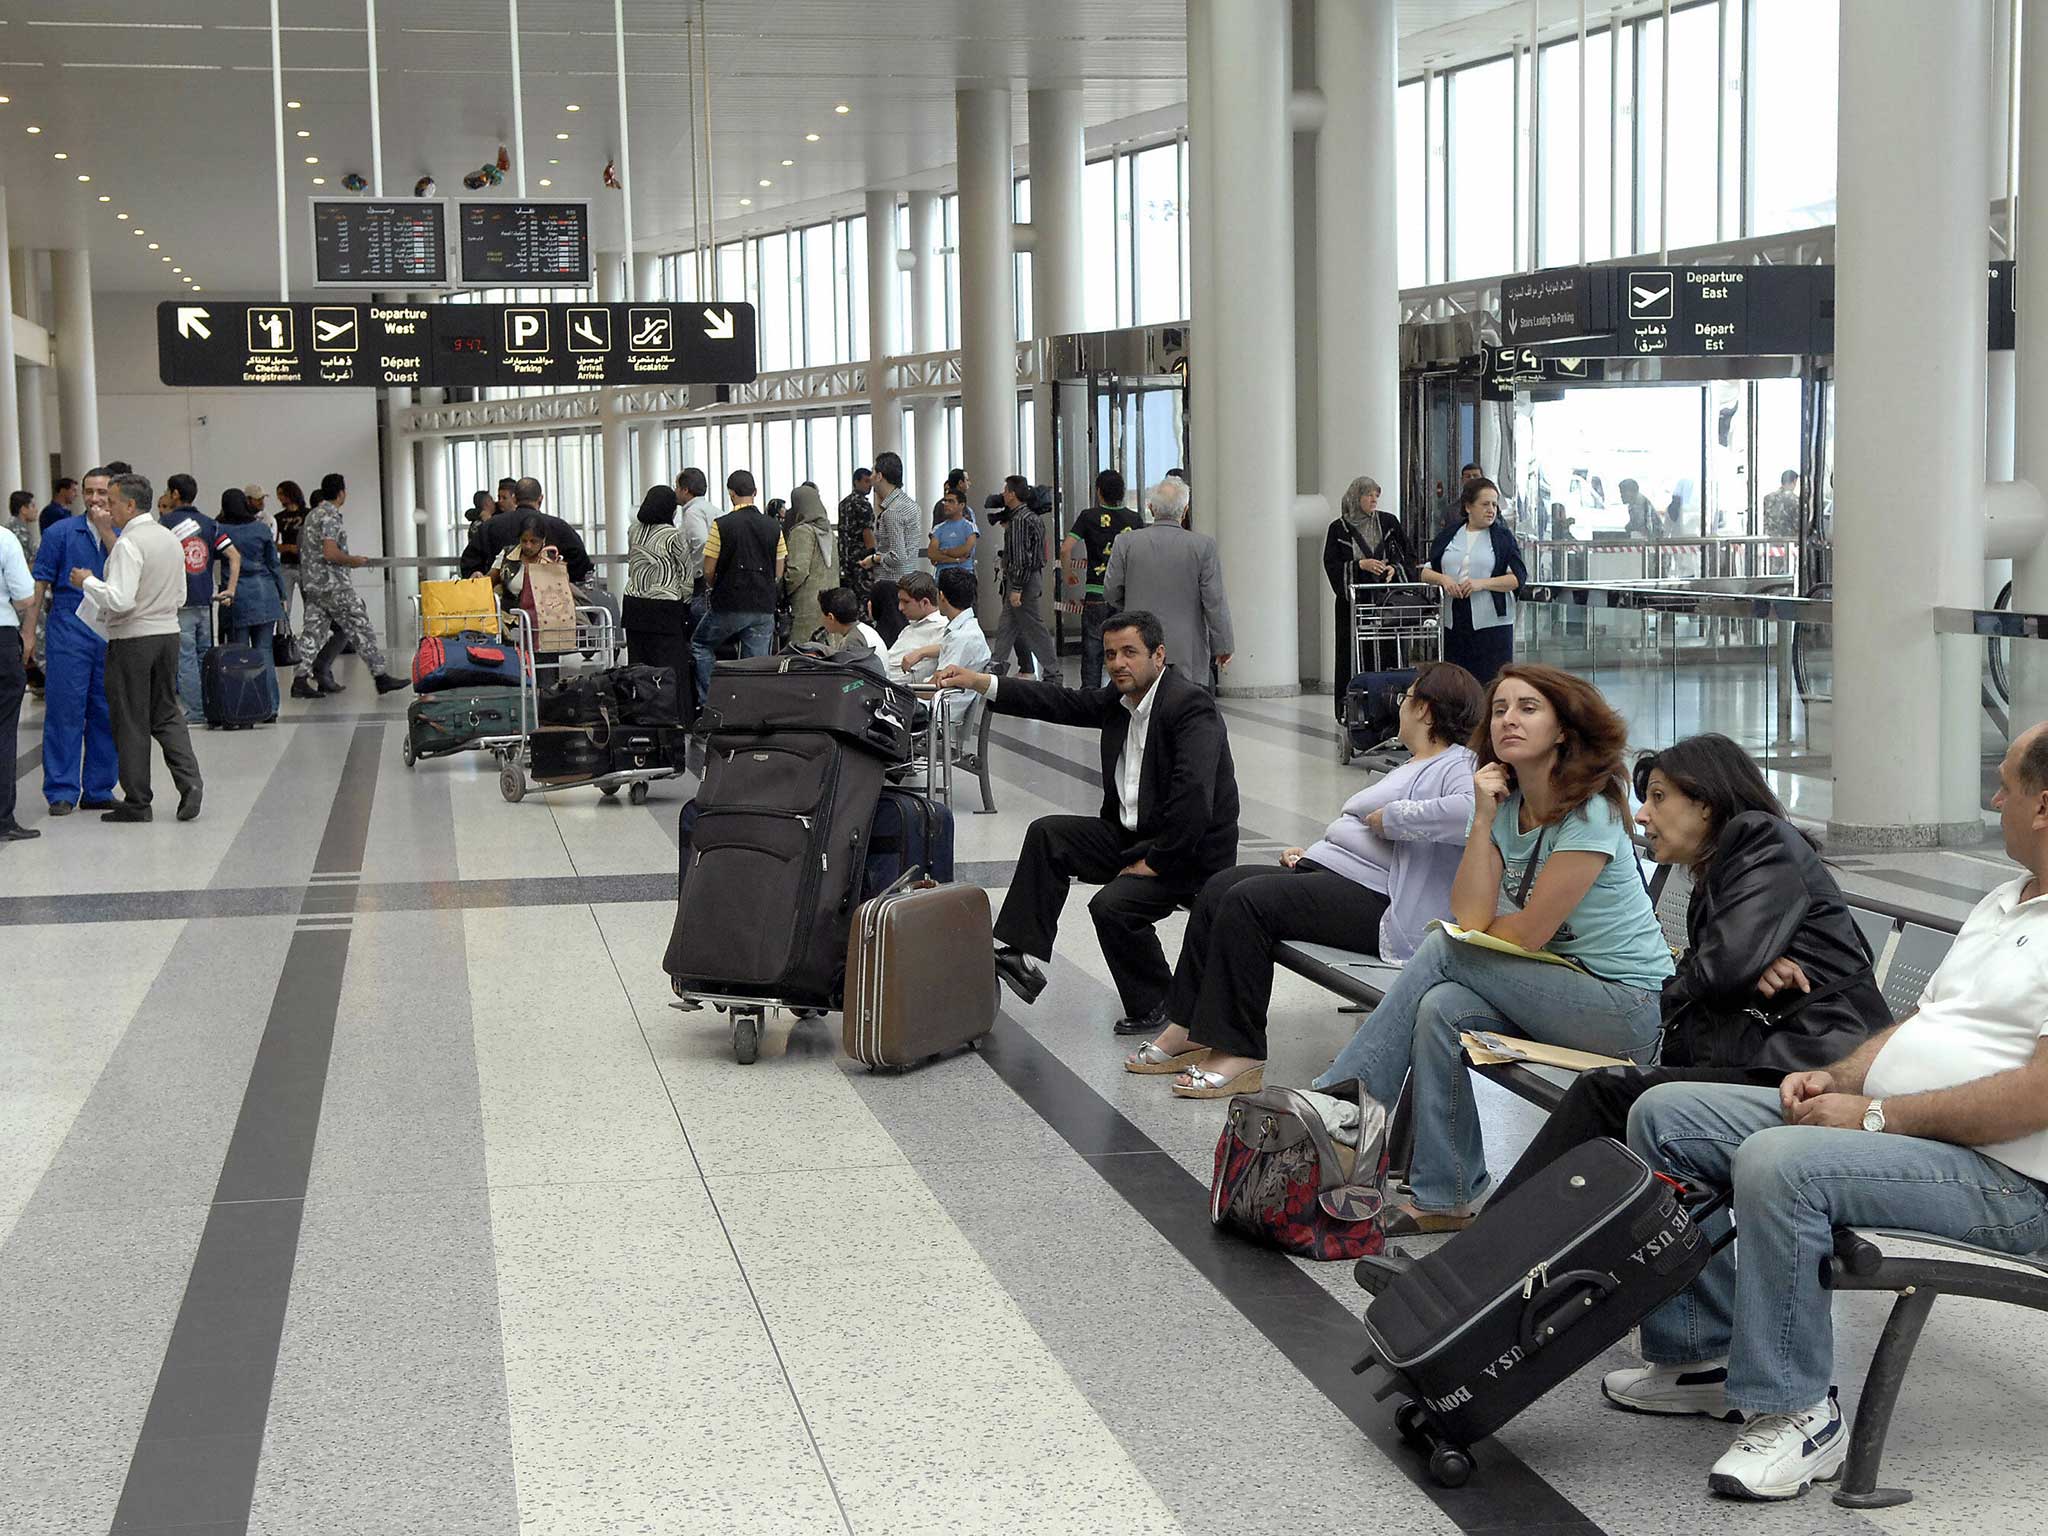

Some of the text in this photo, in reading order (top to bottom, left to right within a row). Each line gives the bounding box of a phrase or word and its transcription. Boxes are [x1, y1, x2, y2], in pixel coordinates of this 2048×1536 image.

[1686, 271, 1744, 285] Departure
[1702, 286, 1728, 299] East
[370, 308, 428, 321] Departure
[1557, 311, 1574, 325] Parking
[384, 322, 415, 334] West
[514, 315, 539, 346] P
[1634, 324, 1667, 337] ذهاب
[1694, 322, 1735, 337] Départ
[1705, 338, 1724, 351] Est
[320, 355, 353, 367] ذهاب
[380, 356, 421, 370] Départ
[634, 363, 670, 371] Escalator
[514, 364, 542, 374] Parking
[578, 364, 603, 372] Arrival
[243, 372, 301, 382] Enregistrement
[384, 371, 418, 382] Ouest
